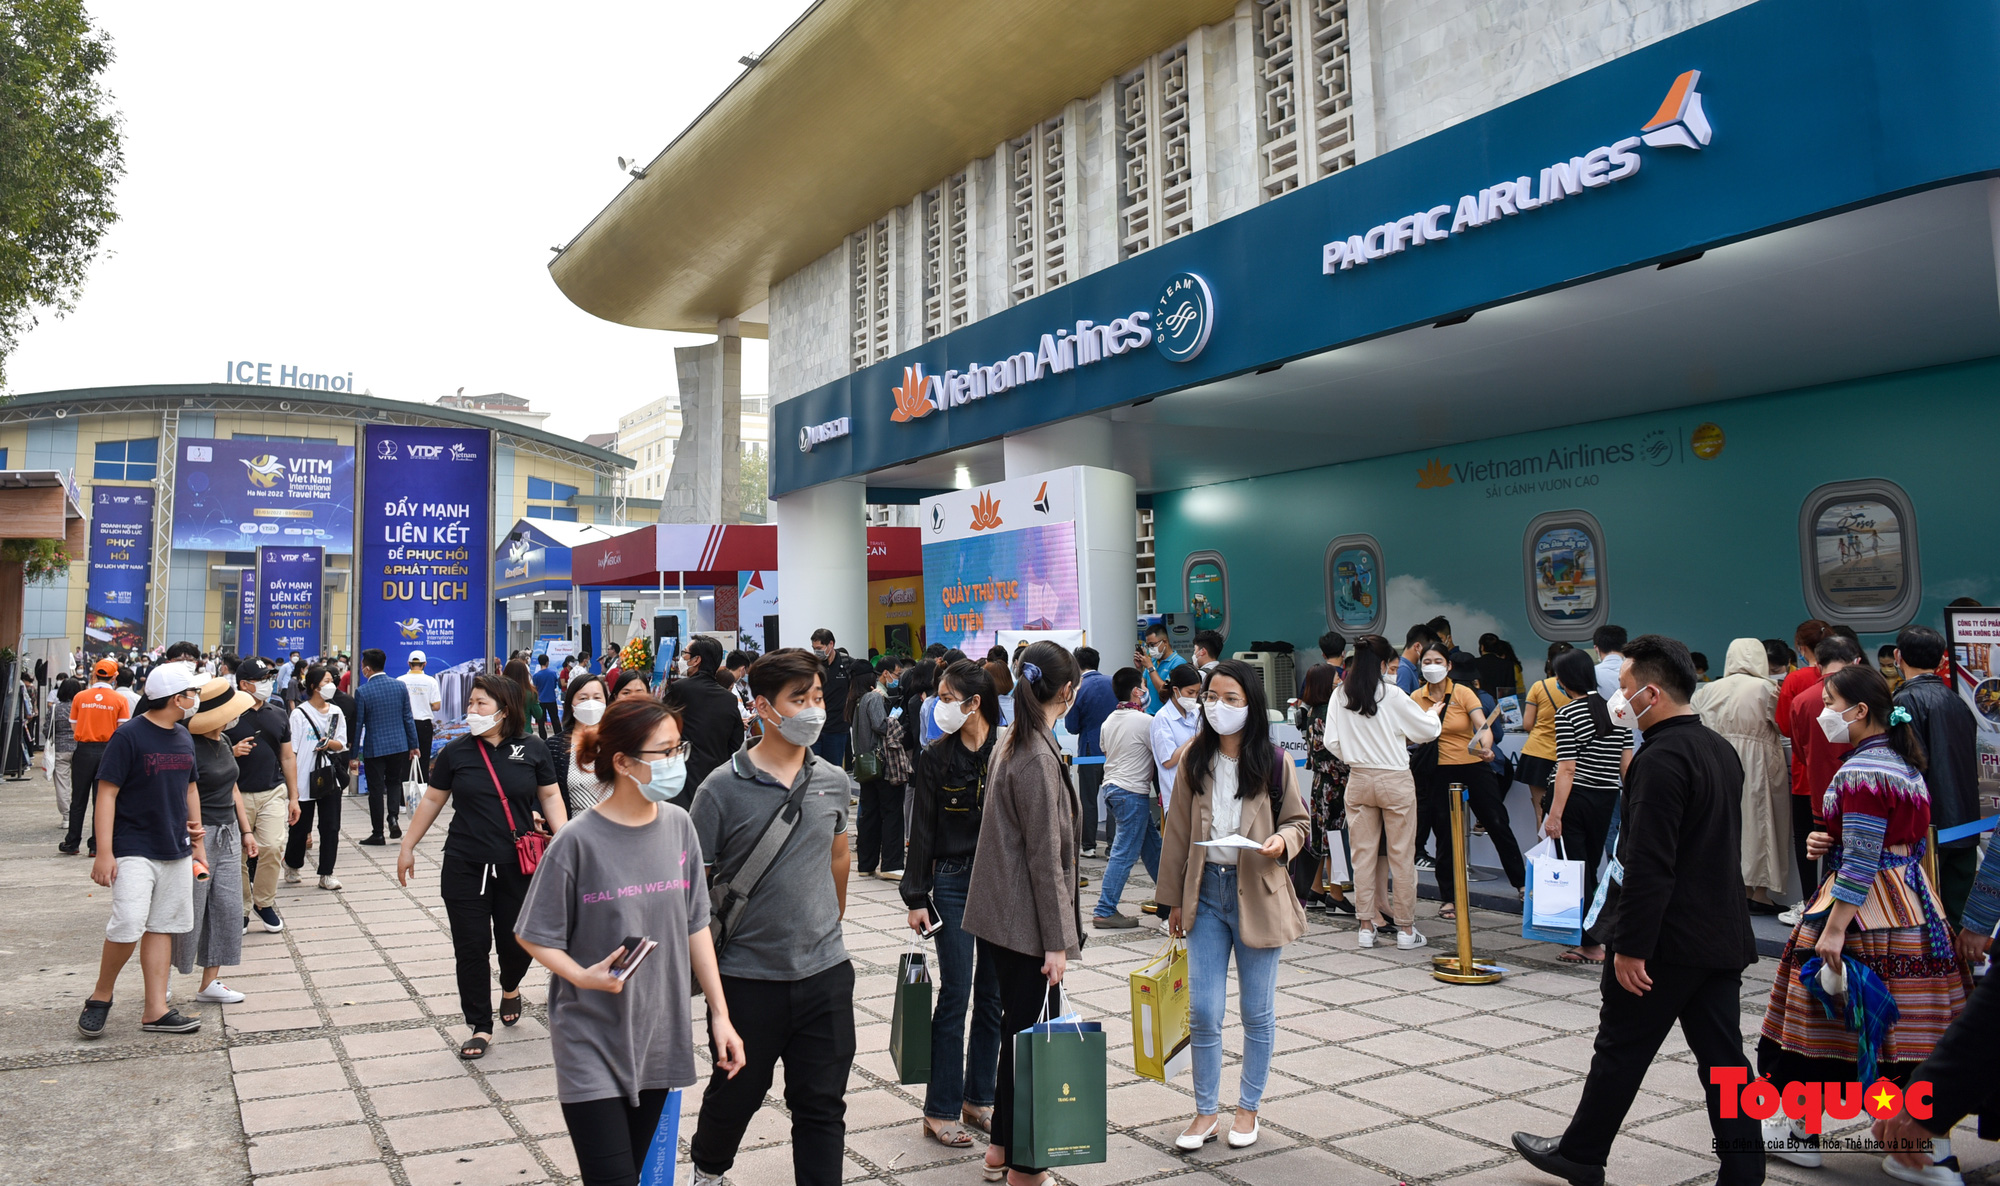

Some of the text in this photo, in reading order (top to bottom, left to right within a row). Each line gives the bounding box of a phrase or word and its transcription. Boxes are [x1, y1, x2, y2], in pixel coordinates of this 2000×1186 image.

[1322, 136, 1641, 275] PACIFIC AIRLINES
[1156, 278, 1192, 343] SKYTEAM
[928, 310, 1152, 411] Vietnam Airlines
[227, 361, 353, 392] ICE Hanoi
[407, 445, 444, 457] VTDF
[289, 458, 332, 474] VITM
[1454, 443, 1635, 484] Vietnam Airlines
[288, 473, 332, 484] Viet Nam
[1574, 474, 1600, 488] CAO
[288, 490, 331, 499] Travel Mart
[289, 483, 332, 492] International
[385, 496, 469, 520] ĐẨY MẠNH
[385, 521, 470, 543] LIÊN KẾT
[106, 539, 135, 549] PHỤC
[388, 545, 404, 559] ĐỂ
[406, 550, 443, 562] PHỤC
[384, 562, 469, 575] & PHÁT TRIỂN
[289, 582, 312, 591] MẠNH
[382, 581, 467, 605] DU LỊCH
[942, 576, 1018, 608] QUẦY THỦ TỤC
[270, 590, 312, 601] LIÊN KẾT
[269, 619, 311, 630] DU LỊCH
[426, 619, 454, 628] VITM
[959, 608, 984, 631] TIÊN
[1280, 741, 1308, 751] PACIFIC
[583, 890, 614, 904] REAL
[617, 884, 642, 898] MEN
[645, 880, 679, 893] WEAR
